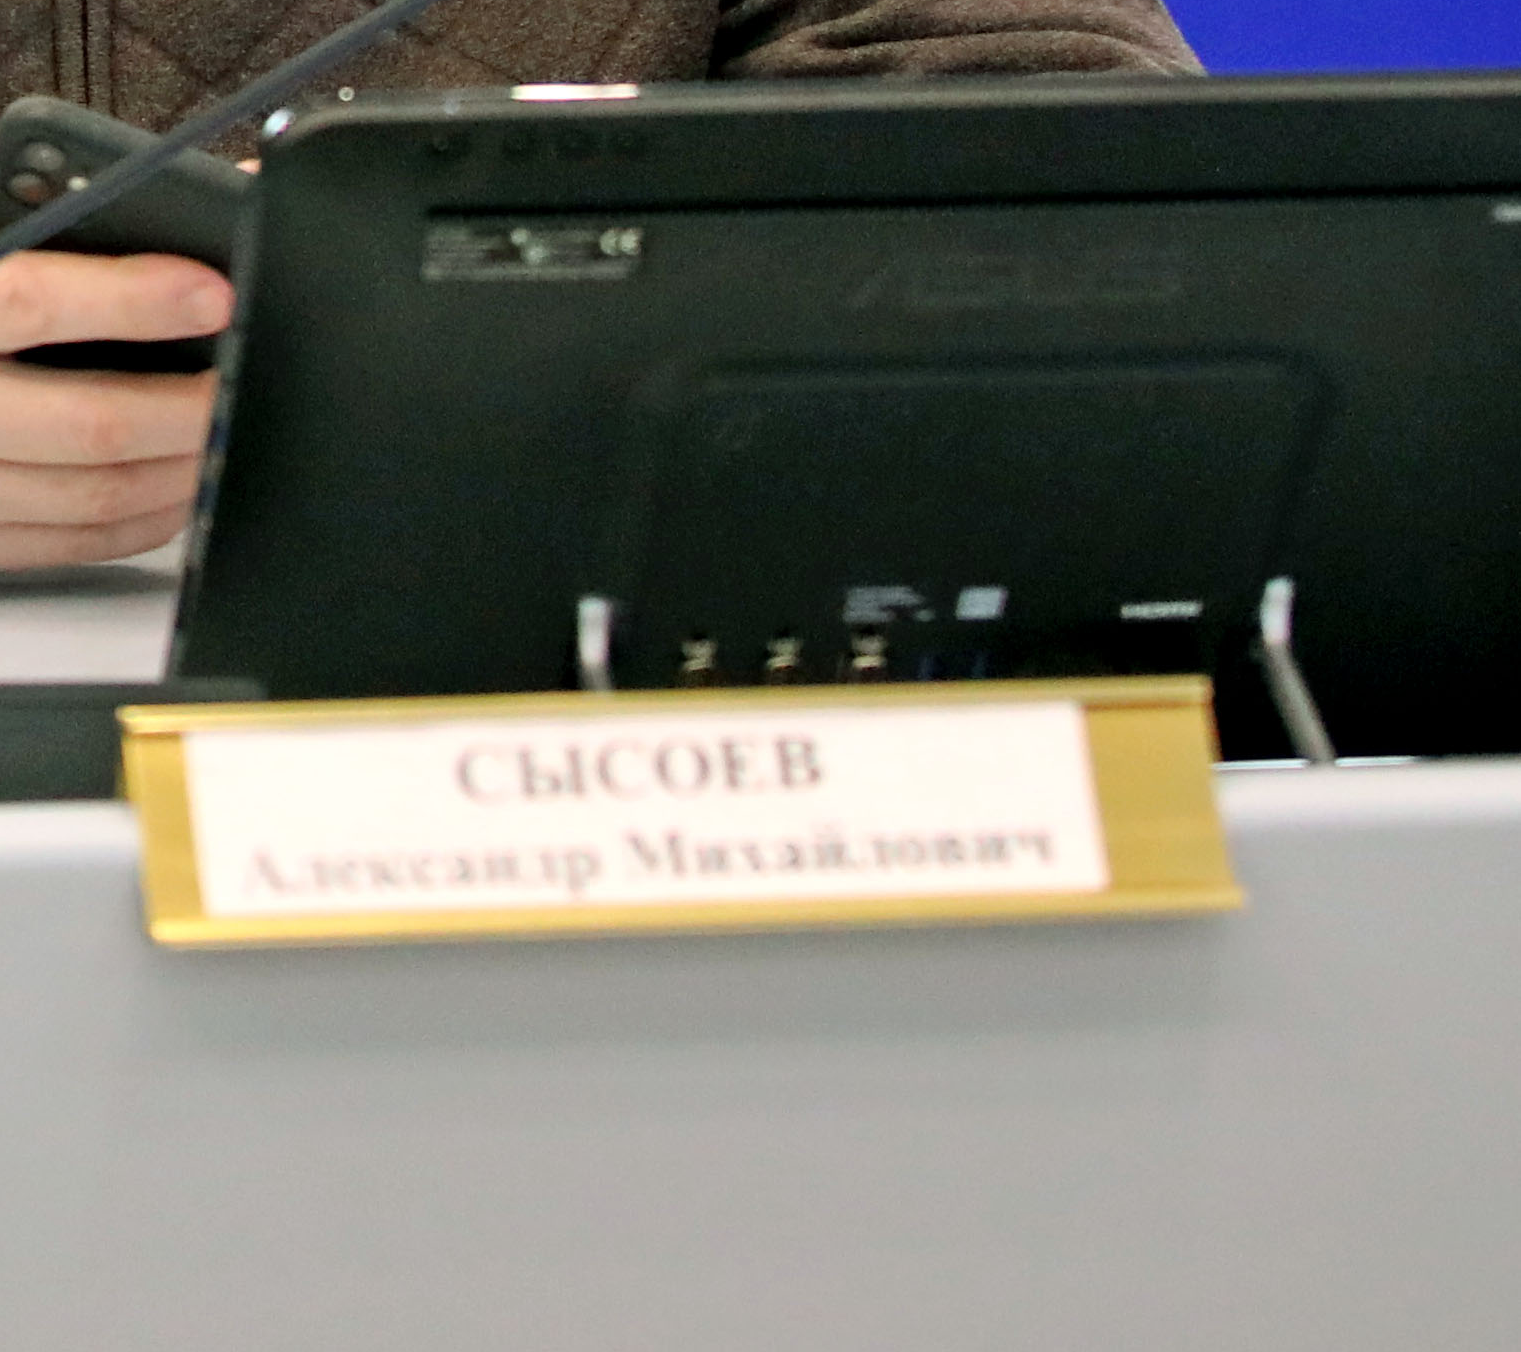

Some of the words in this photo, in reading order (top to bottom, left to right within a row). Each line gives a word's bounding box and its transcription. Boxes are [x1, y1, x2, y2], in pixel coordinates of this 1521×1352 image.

[454, 734, 826, 805] СЫСОЕВ
[244, 842, 604, 898] Александр
[623, 823, 1055, 879] Михайлович
